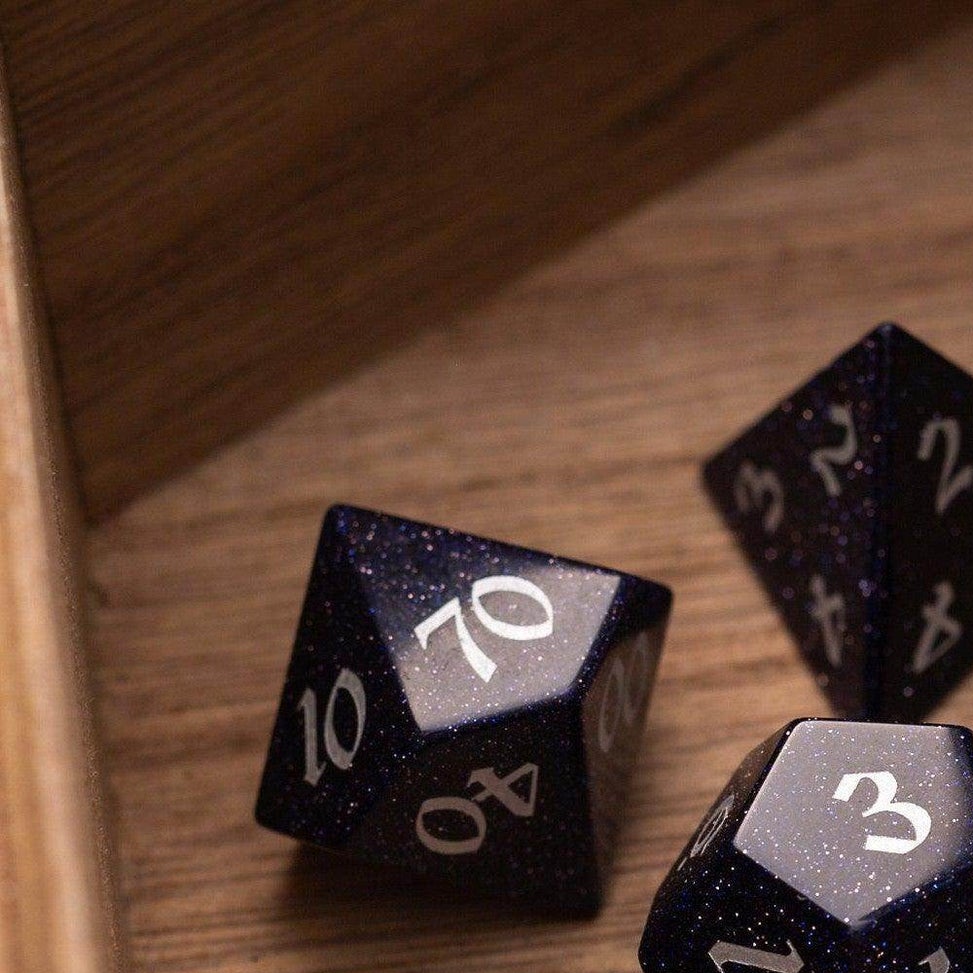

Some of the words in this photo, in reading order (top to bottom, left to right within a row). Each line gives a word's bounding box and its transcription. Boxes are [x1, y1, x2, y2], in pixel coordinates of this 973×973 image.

[811, 404, 857, 496] 2
[414, 575, 553, 682] 70
[912, 581, 962, 673] 4
[297, 667, 367, 786] 10
[416, 762, 538, 855] 40
[832, 771, 931, 854] 3
